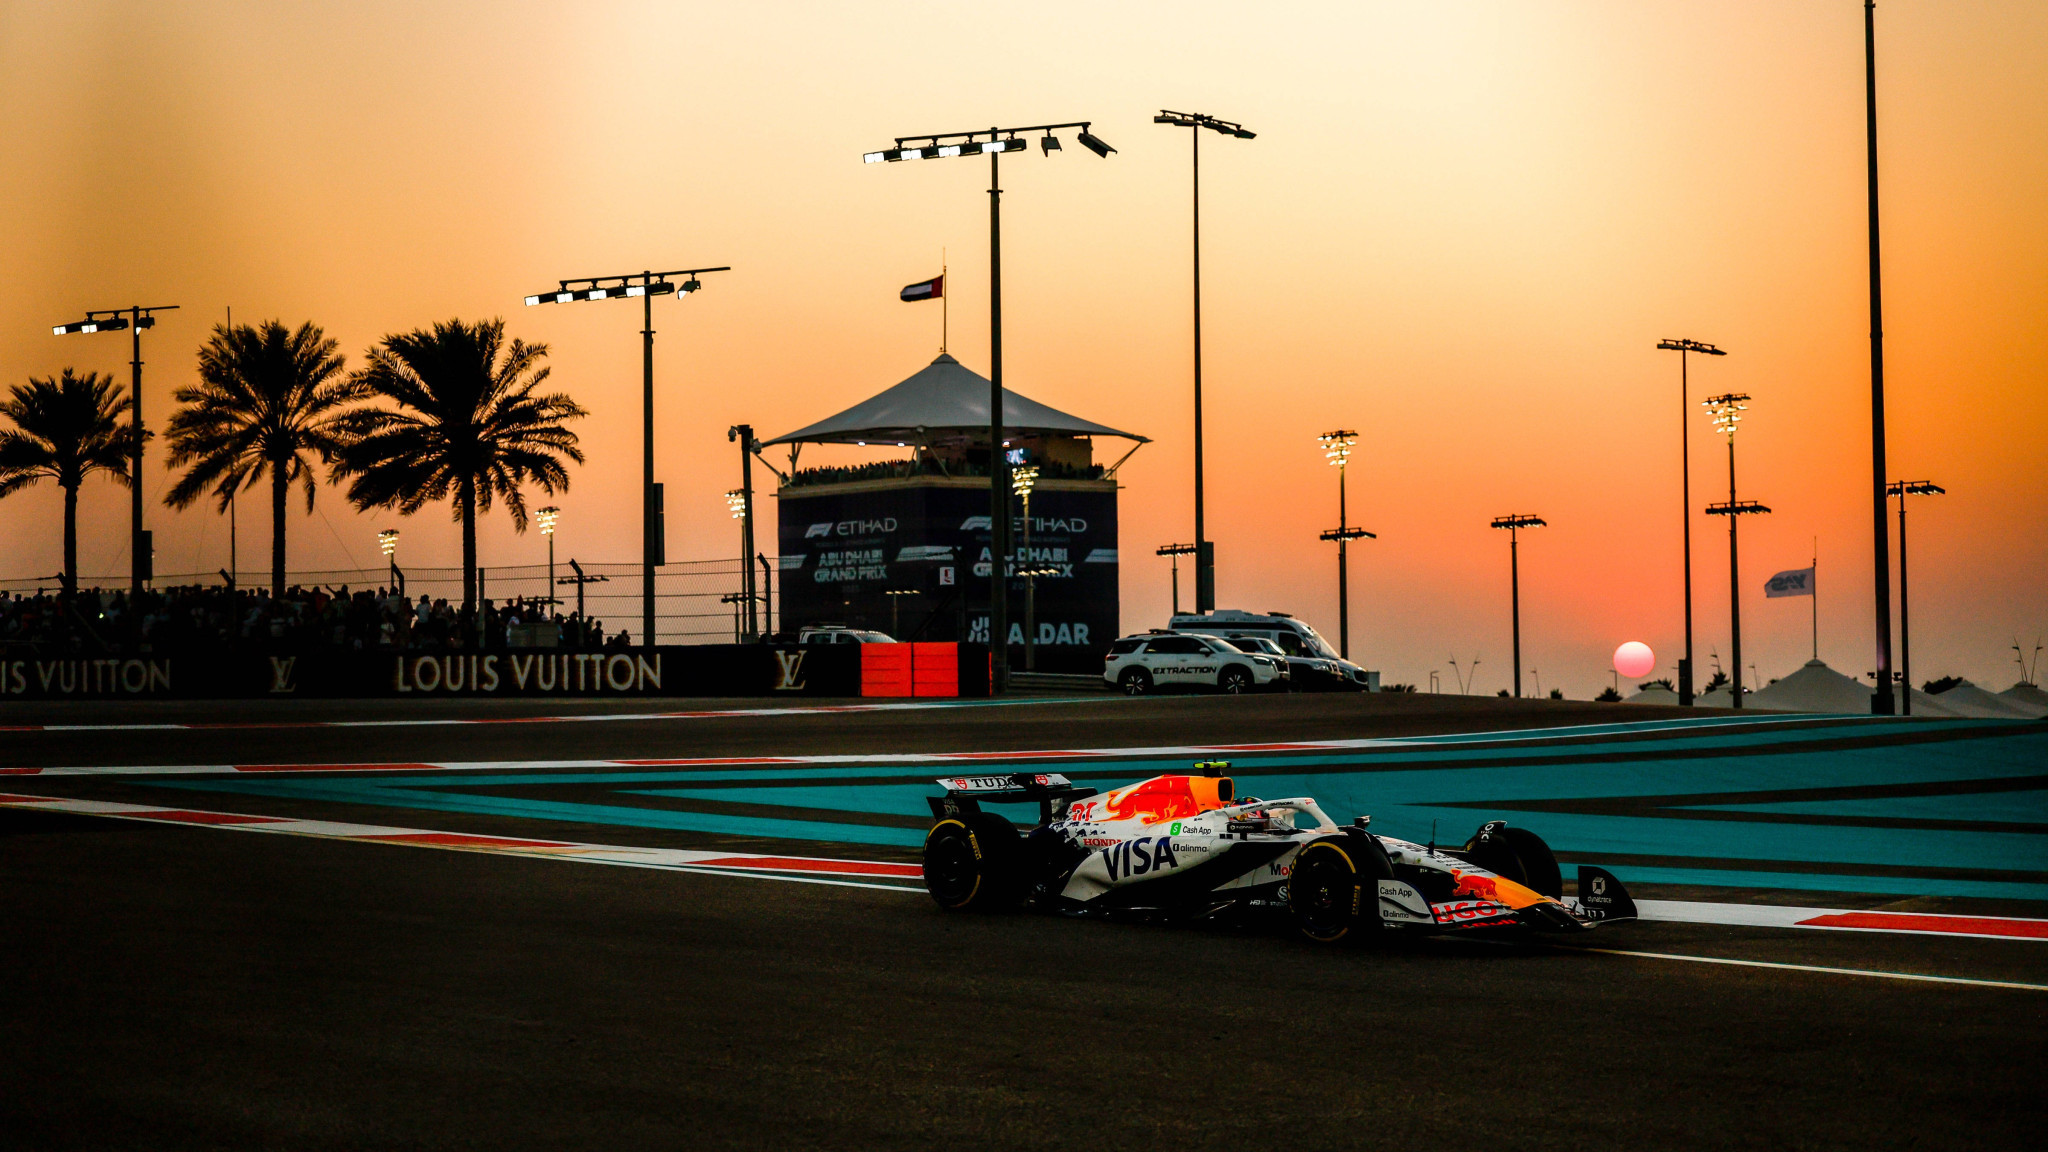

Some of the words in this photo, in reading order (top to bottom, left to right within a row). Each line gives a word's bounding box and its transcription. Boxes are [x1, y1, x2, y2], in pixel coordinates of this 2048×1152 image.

[836, 517, 898, 535] ETIHAD
[818, 551, 844, 567] ABU
[845, 548, 884, 566] DHABI
[813, 566, 857, 583] GRAND
[858, 564, 888, 581] PRIX
[1007, 622, 1090, 645] ADAR
[35, 658, 171, 694] VUITTON
[397, 655, 500, 692] LOUIS
[510, 653, 661, 692] VUITTON
[1153, 666, 1217, 675] EXTRACTION
[1182, 826, 1198, 834] Cash
[1198, 827, 1212, 836] App
[1180, 843, 1208, 853] alinma
[1100, 836, 1179, 882] VISA
[1380, 886, 1397, 896] Cash
[1398, 888, 1413, 898] App
[1431, 901, 1498, 922] UGO
